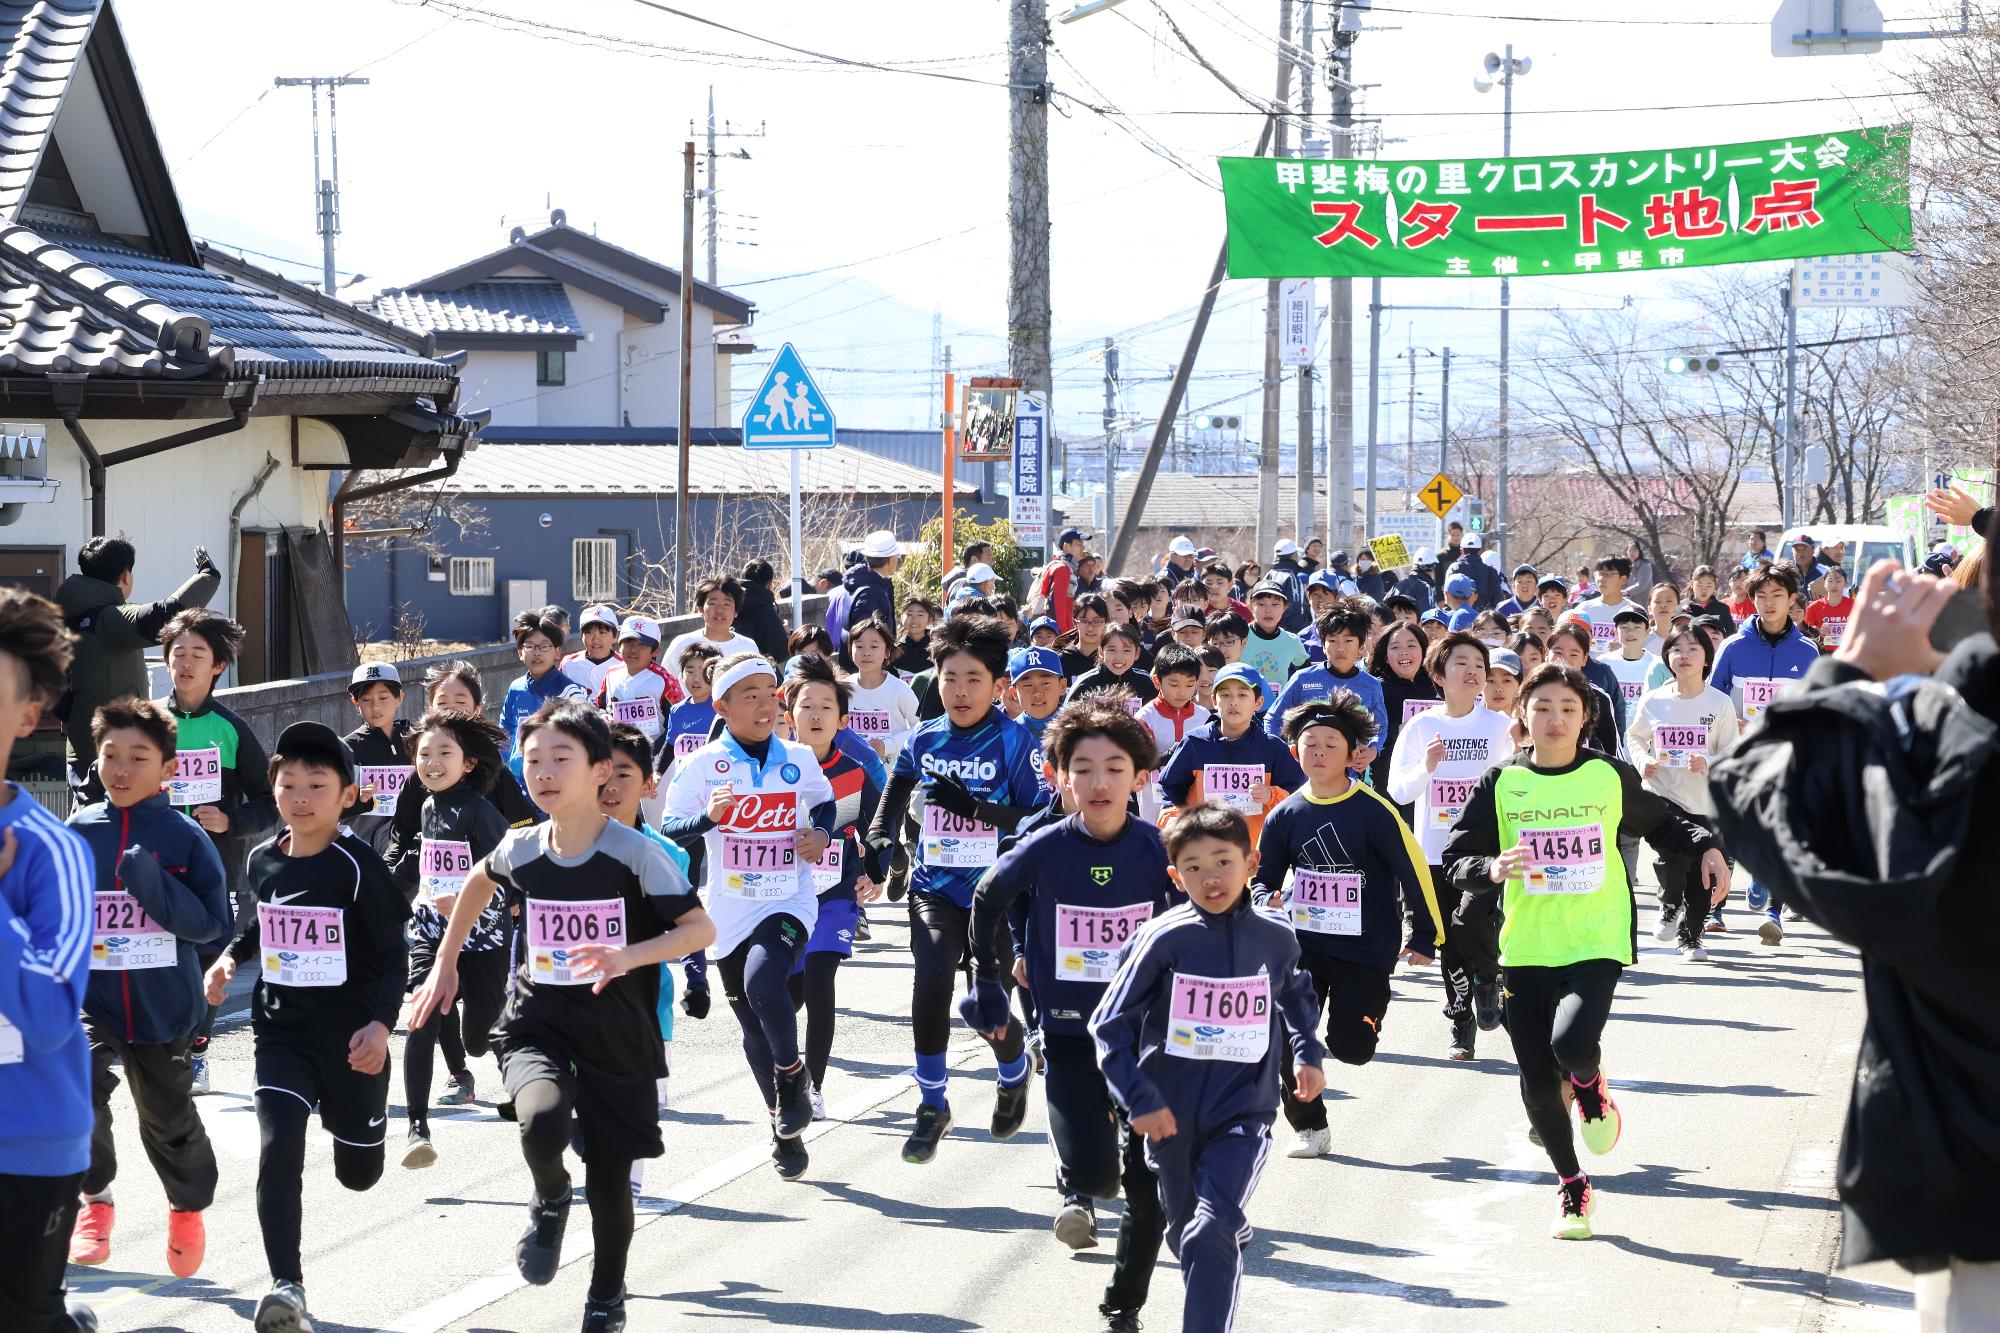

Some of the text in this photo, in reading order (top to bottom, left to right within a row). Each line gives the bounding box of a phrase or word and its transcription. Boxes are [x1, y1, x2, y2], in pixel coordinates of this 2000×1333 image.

[1276, 136, 1850, 195] 甲斐梅の里クロスカントリー大会
[1310, 179, 1824, 249] スタート地点
[1445, 247, 1685, 275] 主催・甲斐市
[1019, 419, 1038, 493] 藤原医院
[1027, 651, 1042, 665] R
[619, 705, 645, 720] 1166
[850, 716, 878, 730] 1188
[1441, 739, 1488, 750] EXISTENCE
[1661, 731, 1694, 746] 1429
[175, 758, 217, 776] 12 D
[1212, 772, 1250, 789] 1193
[719, 795, 796, 833] Lete
[1507, 805, 1607, 822] PENALTY
[962, 841, 995, 849] メイコー
[1530, 836, 1599, 860] 1454 F
[424, 850, 468, 871] 1196 D
[732, 845, 792, 866] 1171 D
[830, 853, 839, 864] D
[764, 875, 795, 883] メイコー
[1570, 866, 1604, 876] メイコー
[1301, 879, 1356, 903] 1211 D
[1328, 911, 1359, 919] メイコー
[269, 916, 338, 945] 1174 D
[539, 913, 619, 941] 1206 D
[1070, 917, 1129, 943] 1153
[133, 937, 173, 948] メイコー
[302, 955, 343, 965] メイコー
[1187, 988, 1265, 1019] 1160 D
[1227, 1030, 1266, 1040] メイコー
